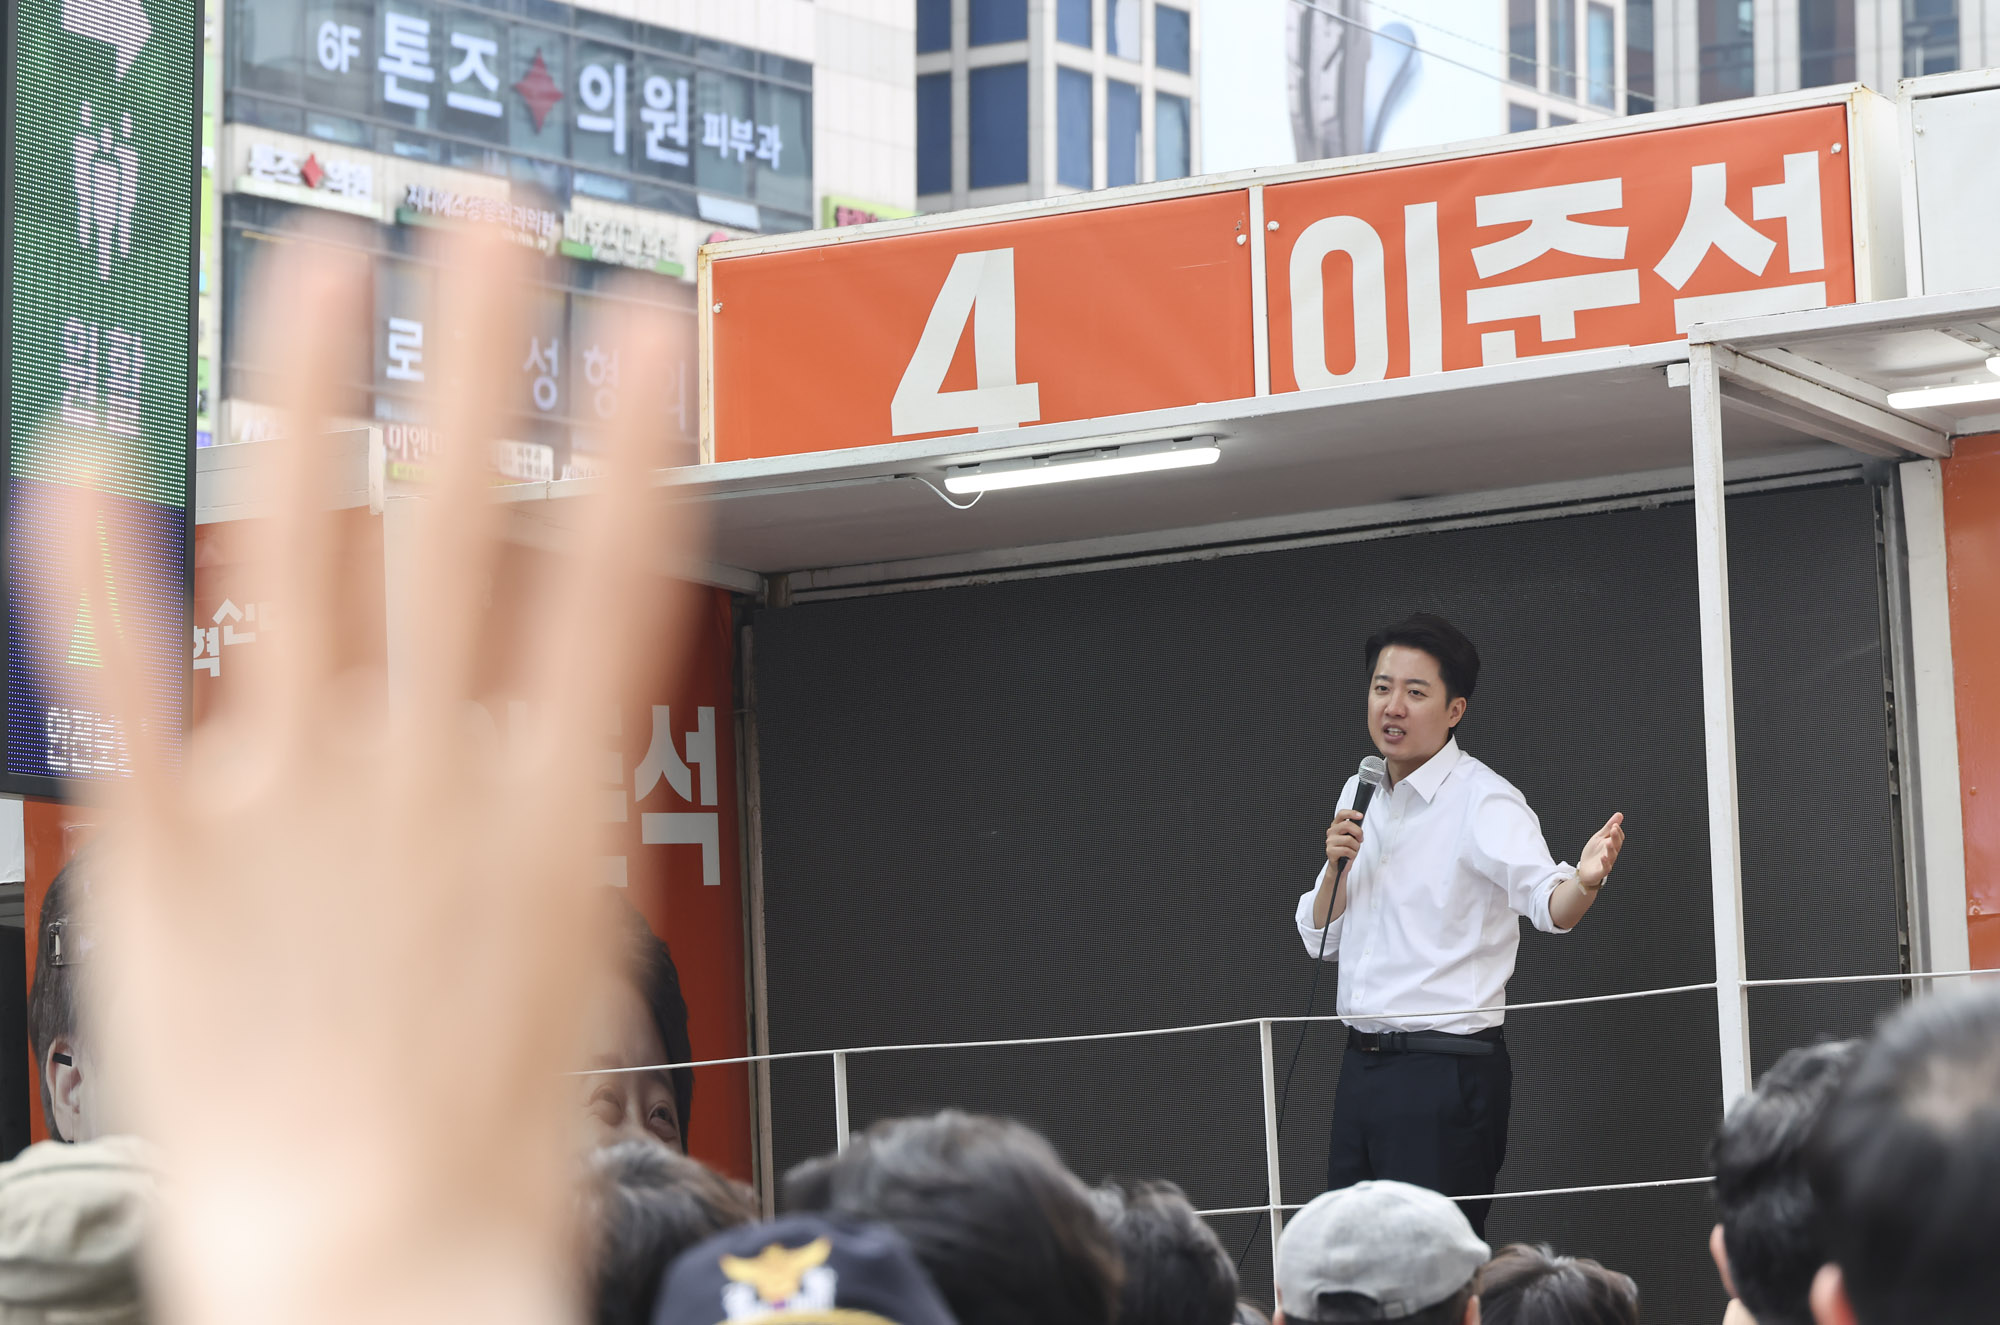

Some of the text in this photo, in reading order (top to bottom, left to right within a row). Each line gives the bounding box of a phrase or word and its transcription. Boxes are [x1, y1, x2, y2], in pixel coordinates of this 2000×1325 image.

[317, 10, 783, 170] 6F 톤즈 의원 피부과
[890, 150, 1827, 436] 4 이준석
[193, 598, 275, 677] 혁신
[603, 704, 721, 886] 석
